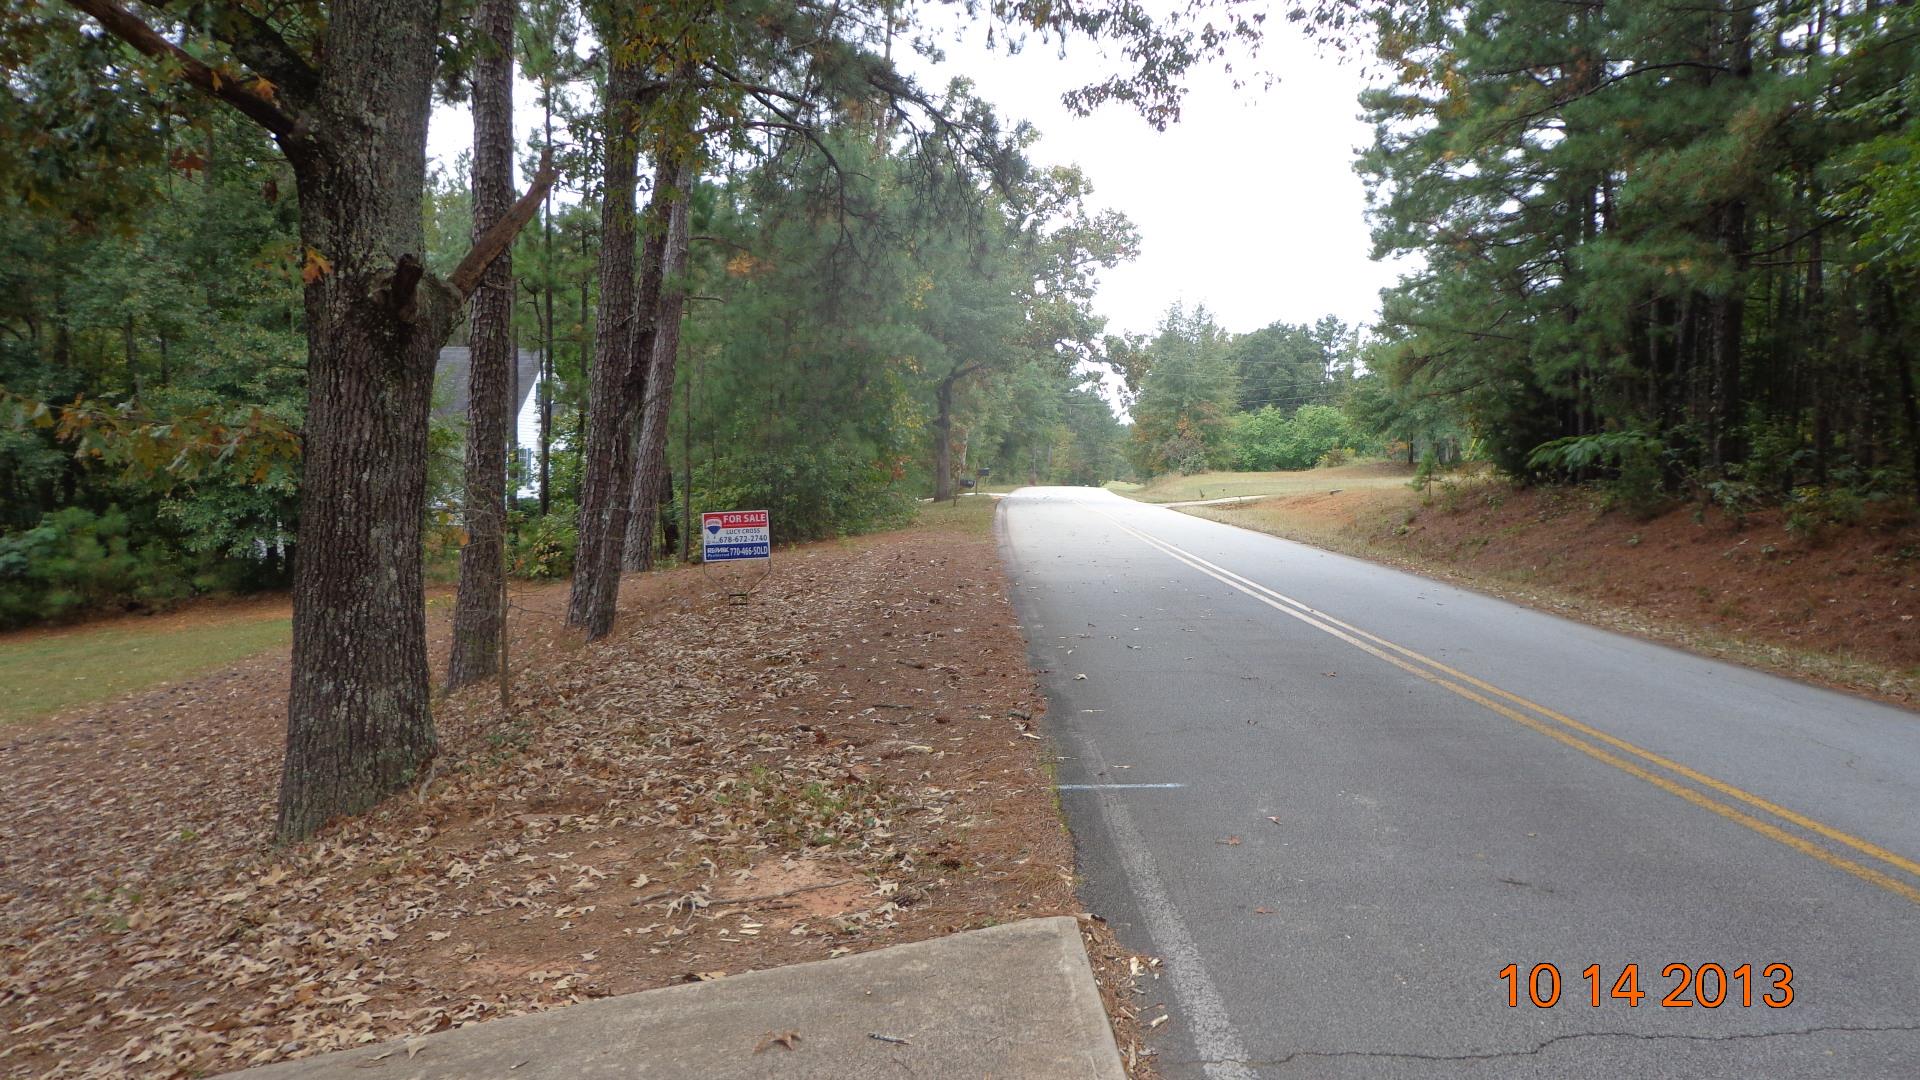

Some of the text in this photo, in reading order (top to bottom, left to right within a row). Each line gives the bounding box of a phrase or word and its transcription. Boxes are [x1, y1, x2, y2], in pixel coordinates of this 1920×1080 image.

[723, 514, 741, 523] FOR
[743, 513, 766, 523] SALE
[719, 535, 768, 543] 678-672-2740
